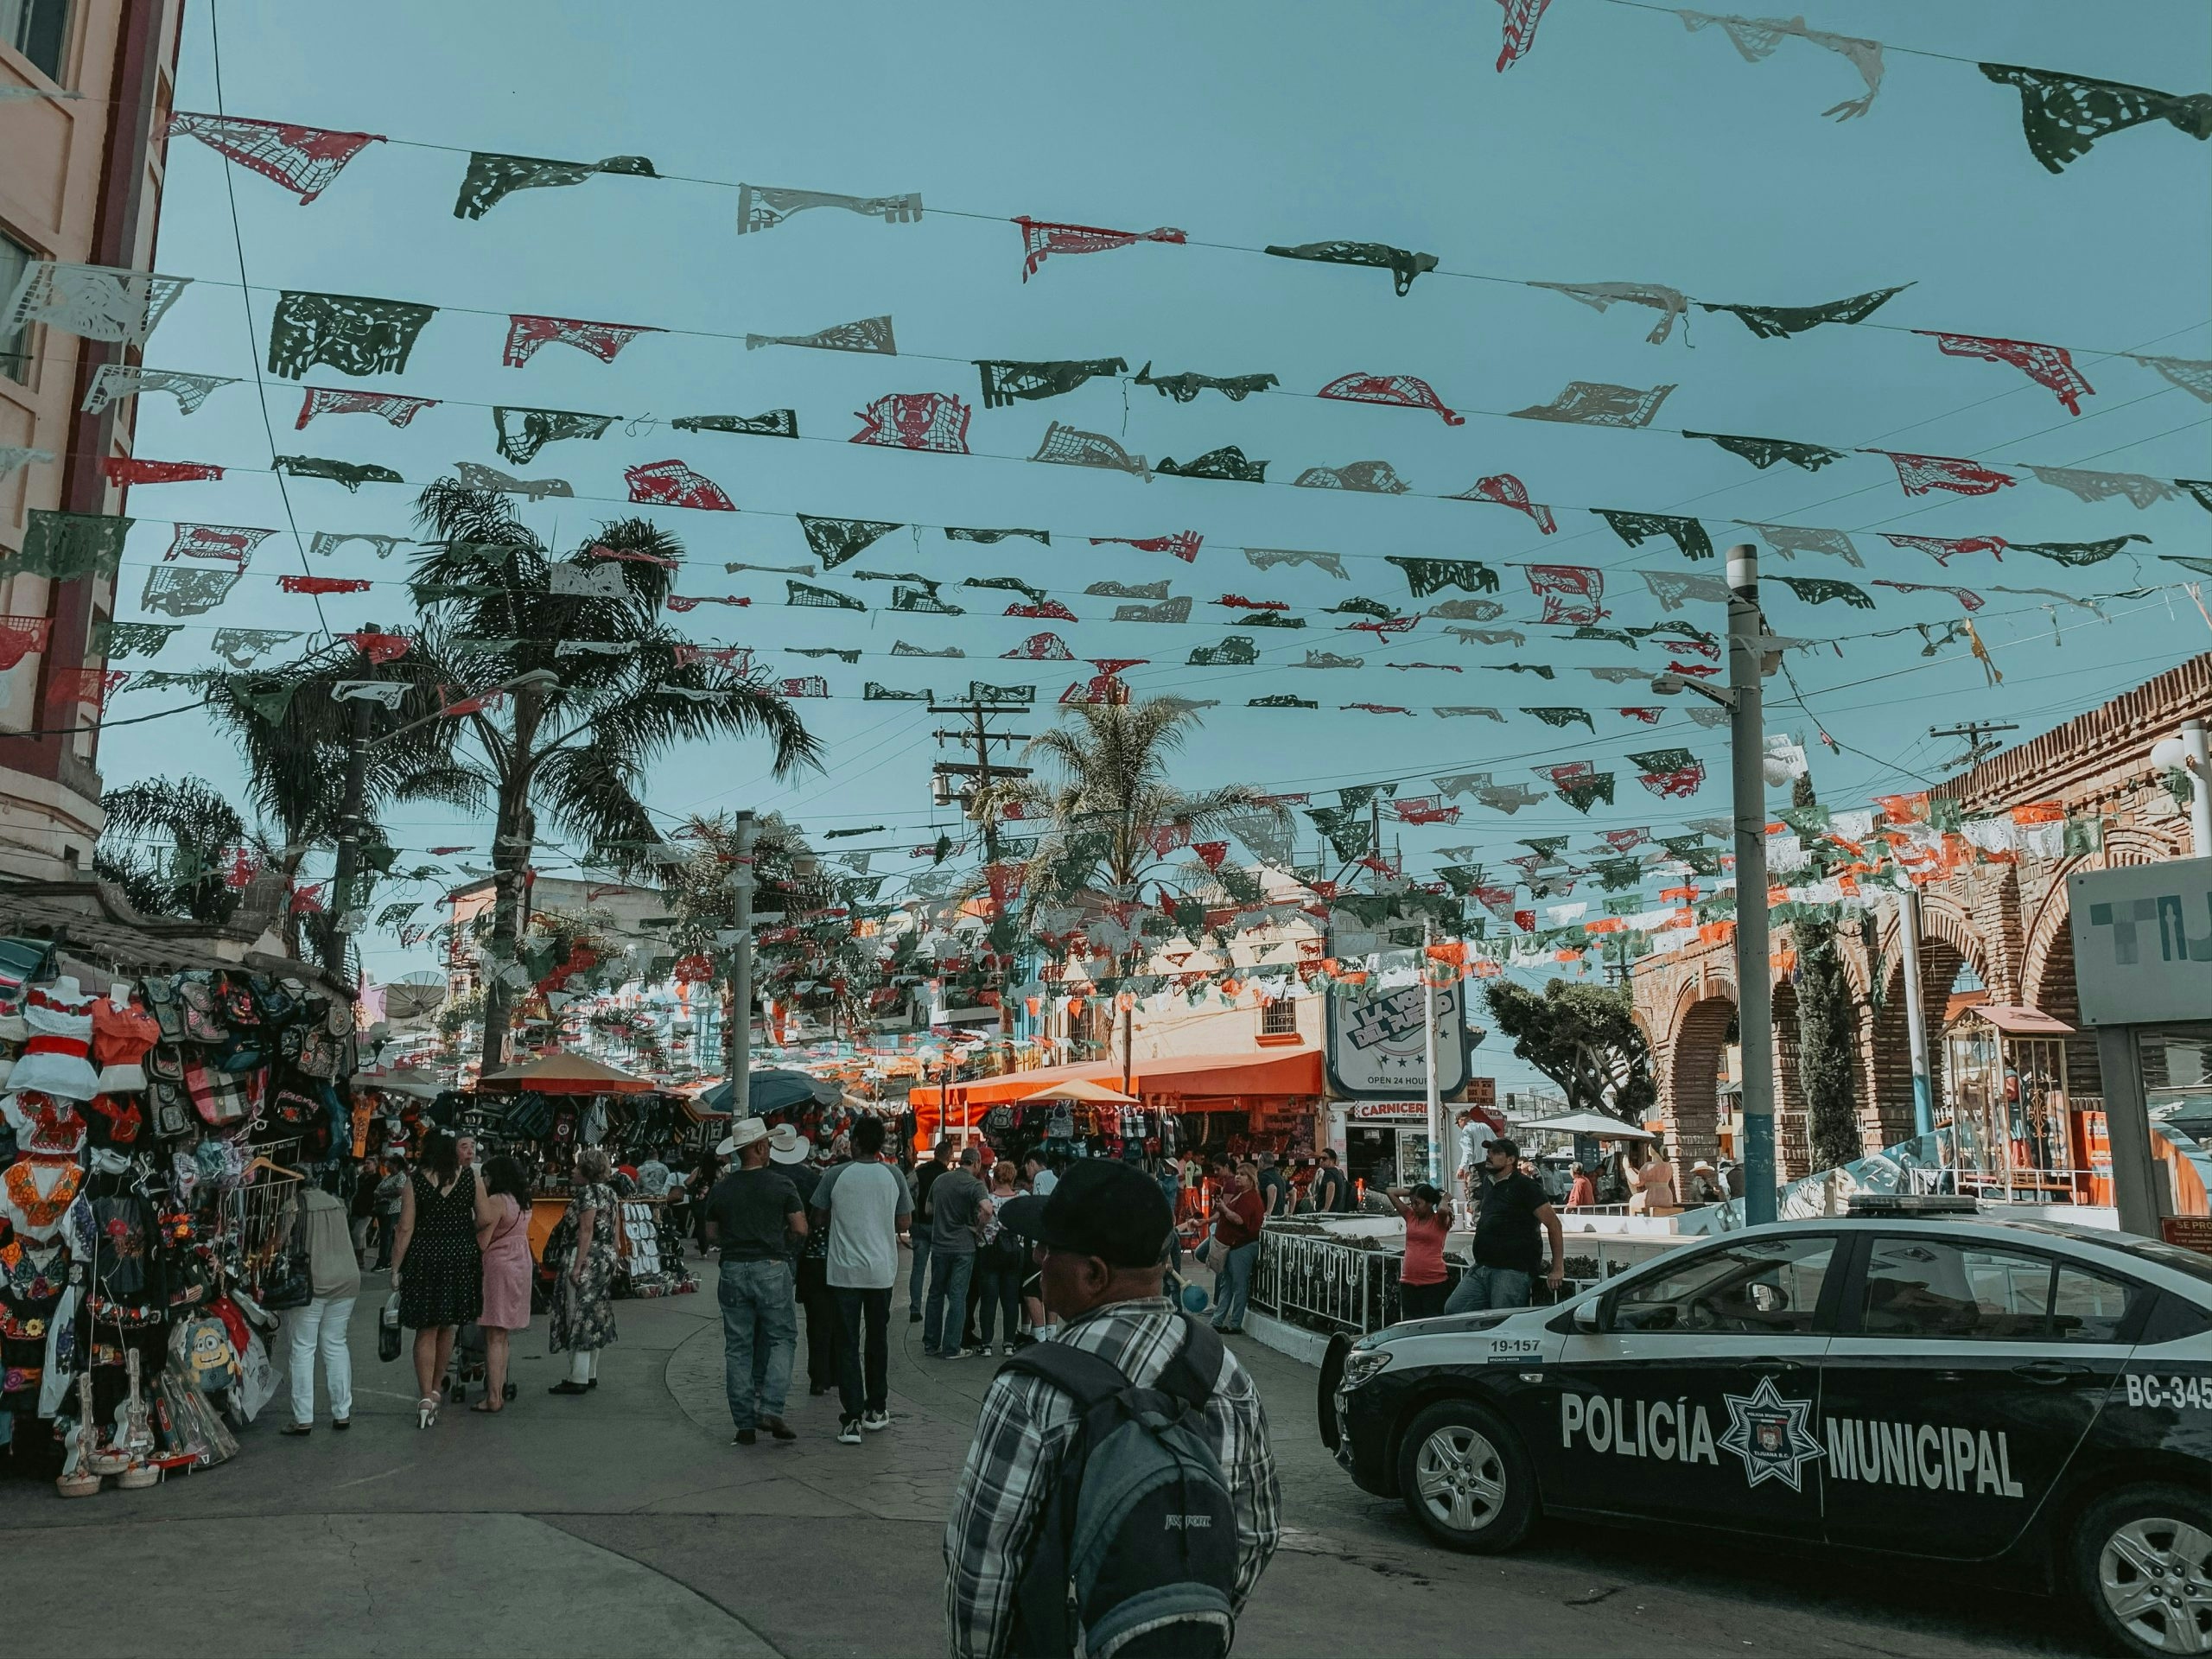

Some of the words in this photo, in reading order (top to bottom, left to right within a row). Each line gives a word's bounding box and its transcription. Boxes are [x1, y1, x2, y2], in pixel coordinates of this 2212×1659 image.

[1359, 1002, 1391, 1027] LA
[1353, 1022, 1390, 1047] DEL
[1361, 1103, 1427, 1116] CARNICERI
[2177, 1221, 2190, 1230] SE
[1491, 1340, 1541, 1352] 19-157
[2126, 1374, 2212, 1409] BC-345
[1561, 1393, 1719, 1465] POLICÍA
[1826, 1417, 2024, 1498] MUNICIPAL
